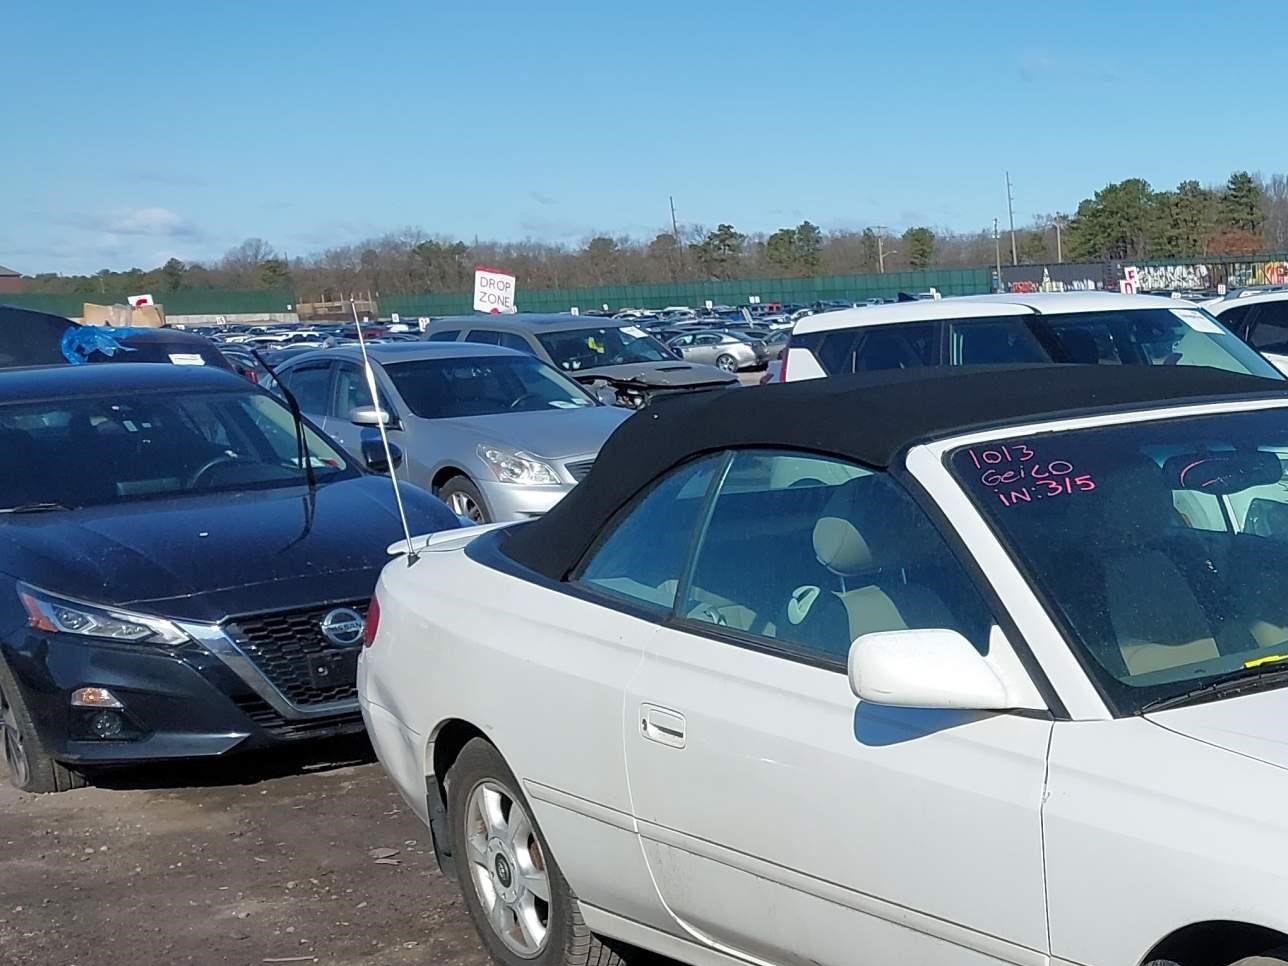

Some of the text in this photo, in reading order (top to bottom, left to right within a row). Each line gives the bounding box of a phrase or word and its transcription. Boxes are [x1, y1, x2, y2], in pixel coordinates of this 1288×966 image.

[479, 276, 511, 293] DROP
[479, 292, 511, 309] ZONE
[968, 445, 1034, 469] 1013
